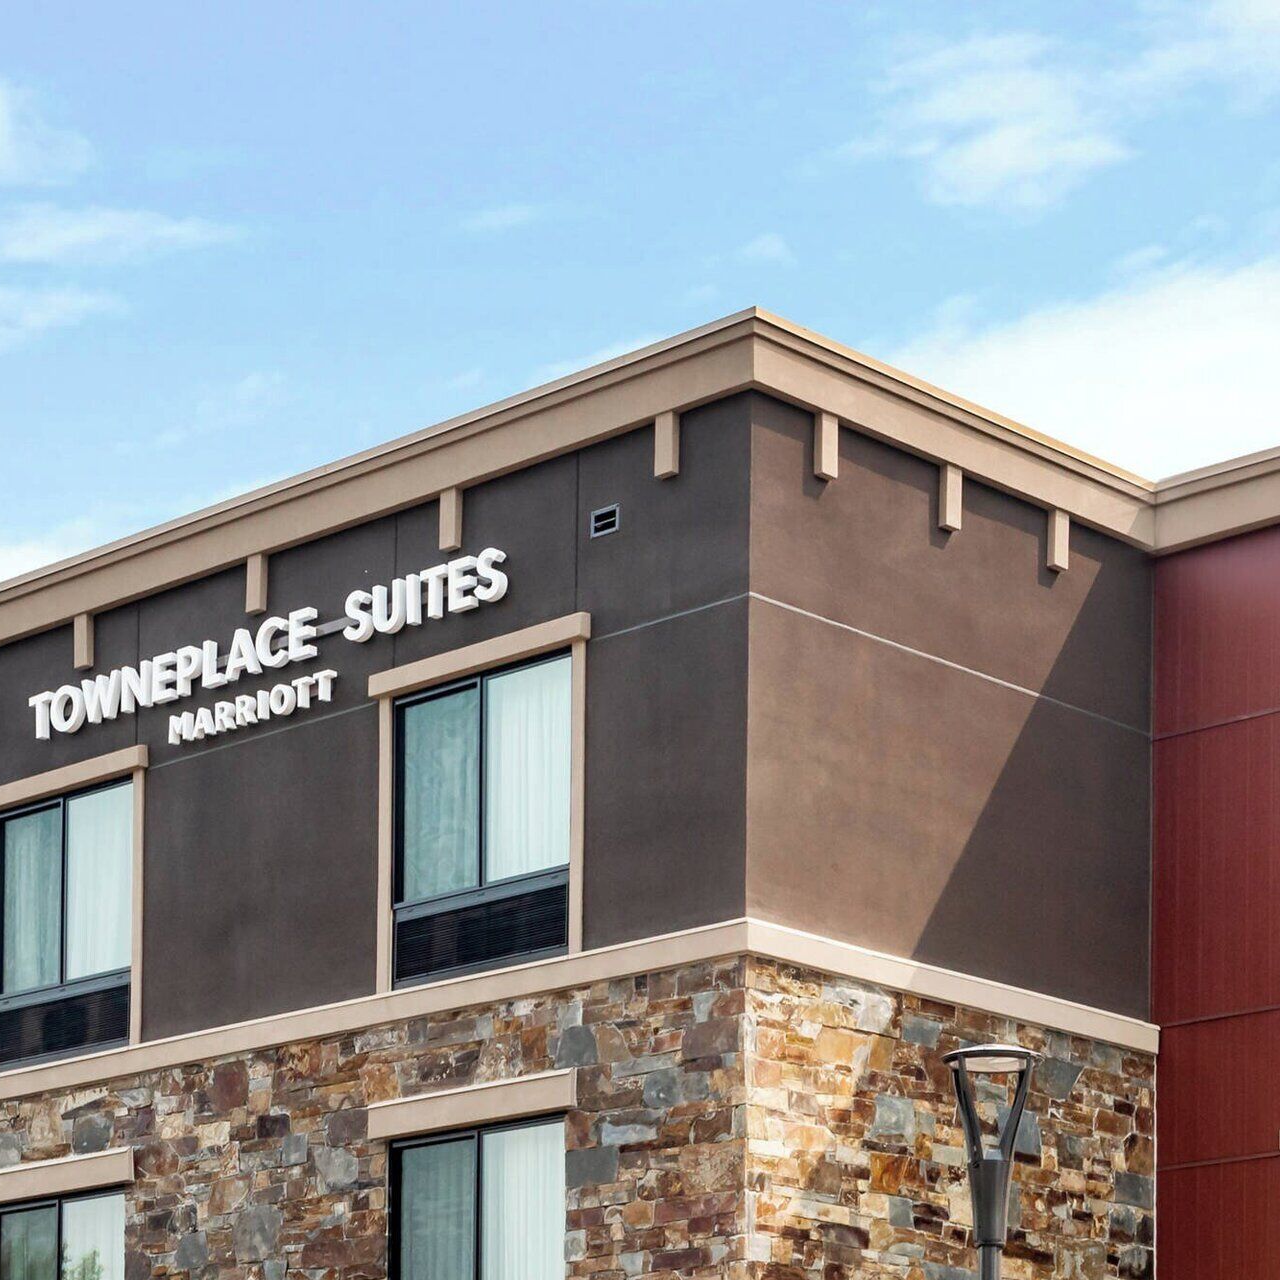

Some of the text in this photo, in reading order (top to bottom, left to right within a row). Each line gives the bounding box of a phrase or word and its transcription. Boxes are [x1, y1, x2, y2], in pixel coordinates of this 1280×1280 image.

[28, 547, 508, 740] TOWNEPLACE SUITES
[168, 669, 338, 745] MARRIOTT
